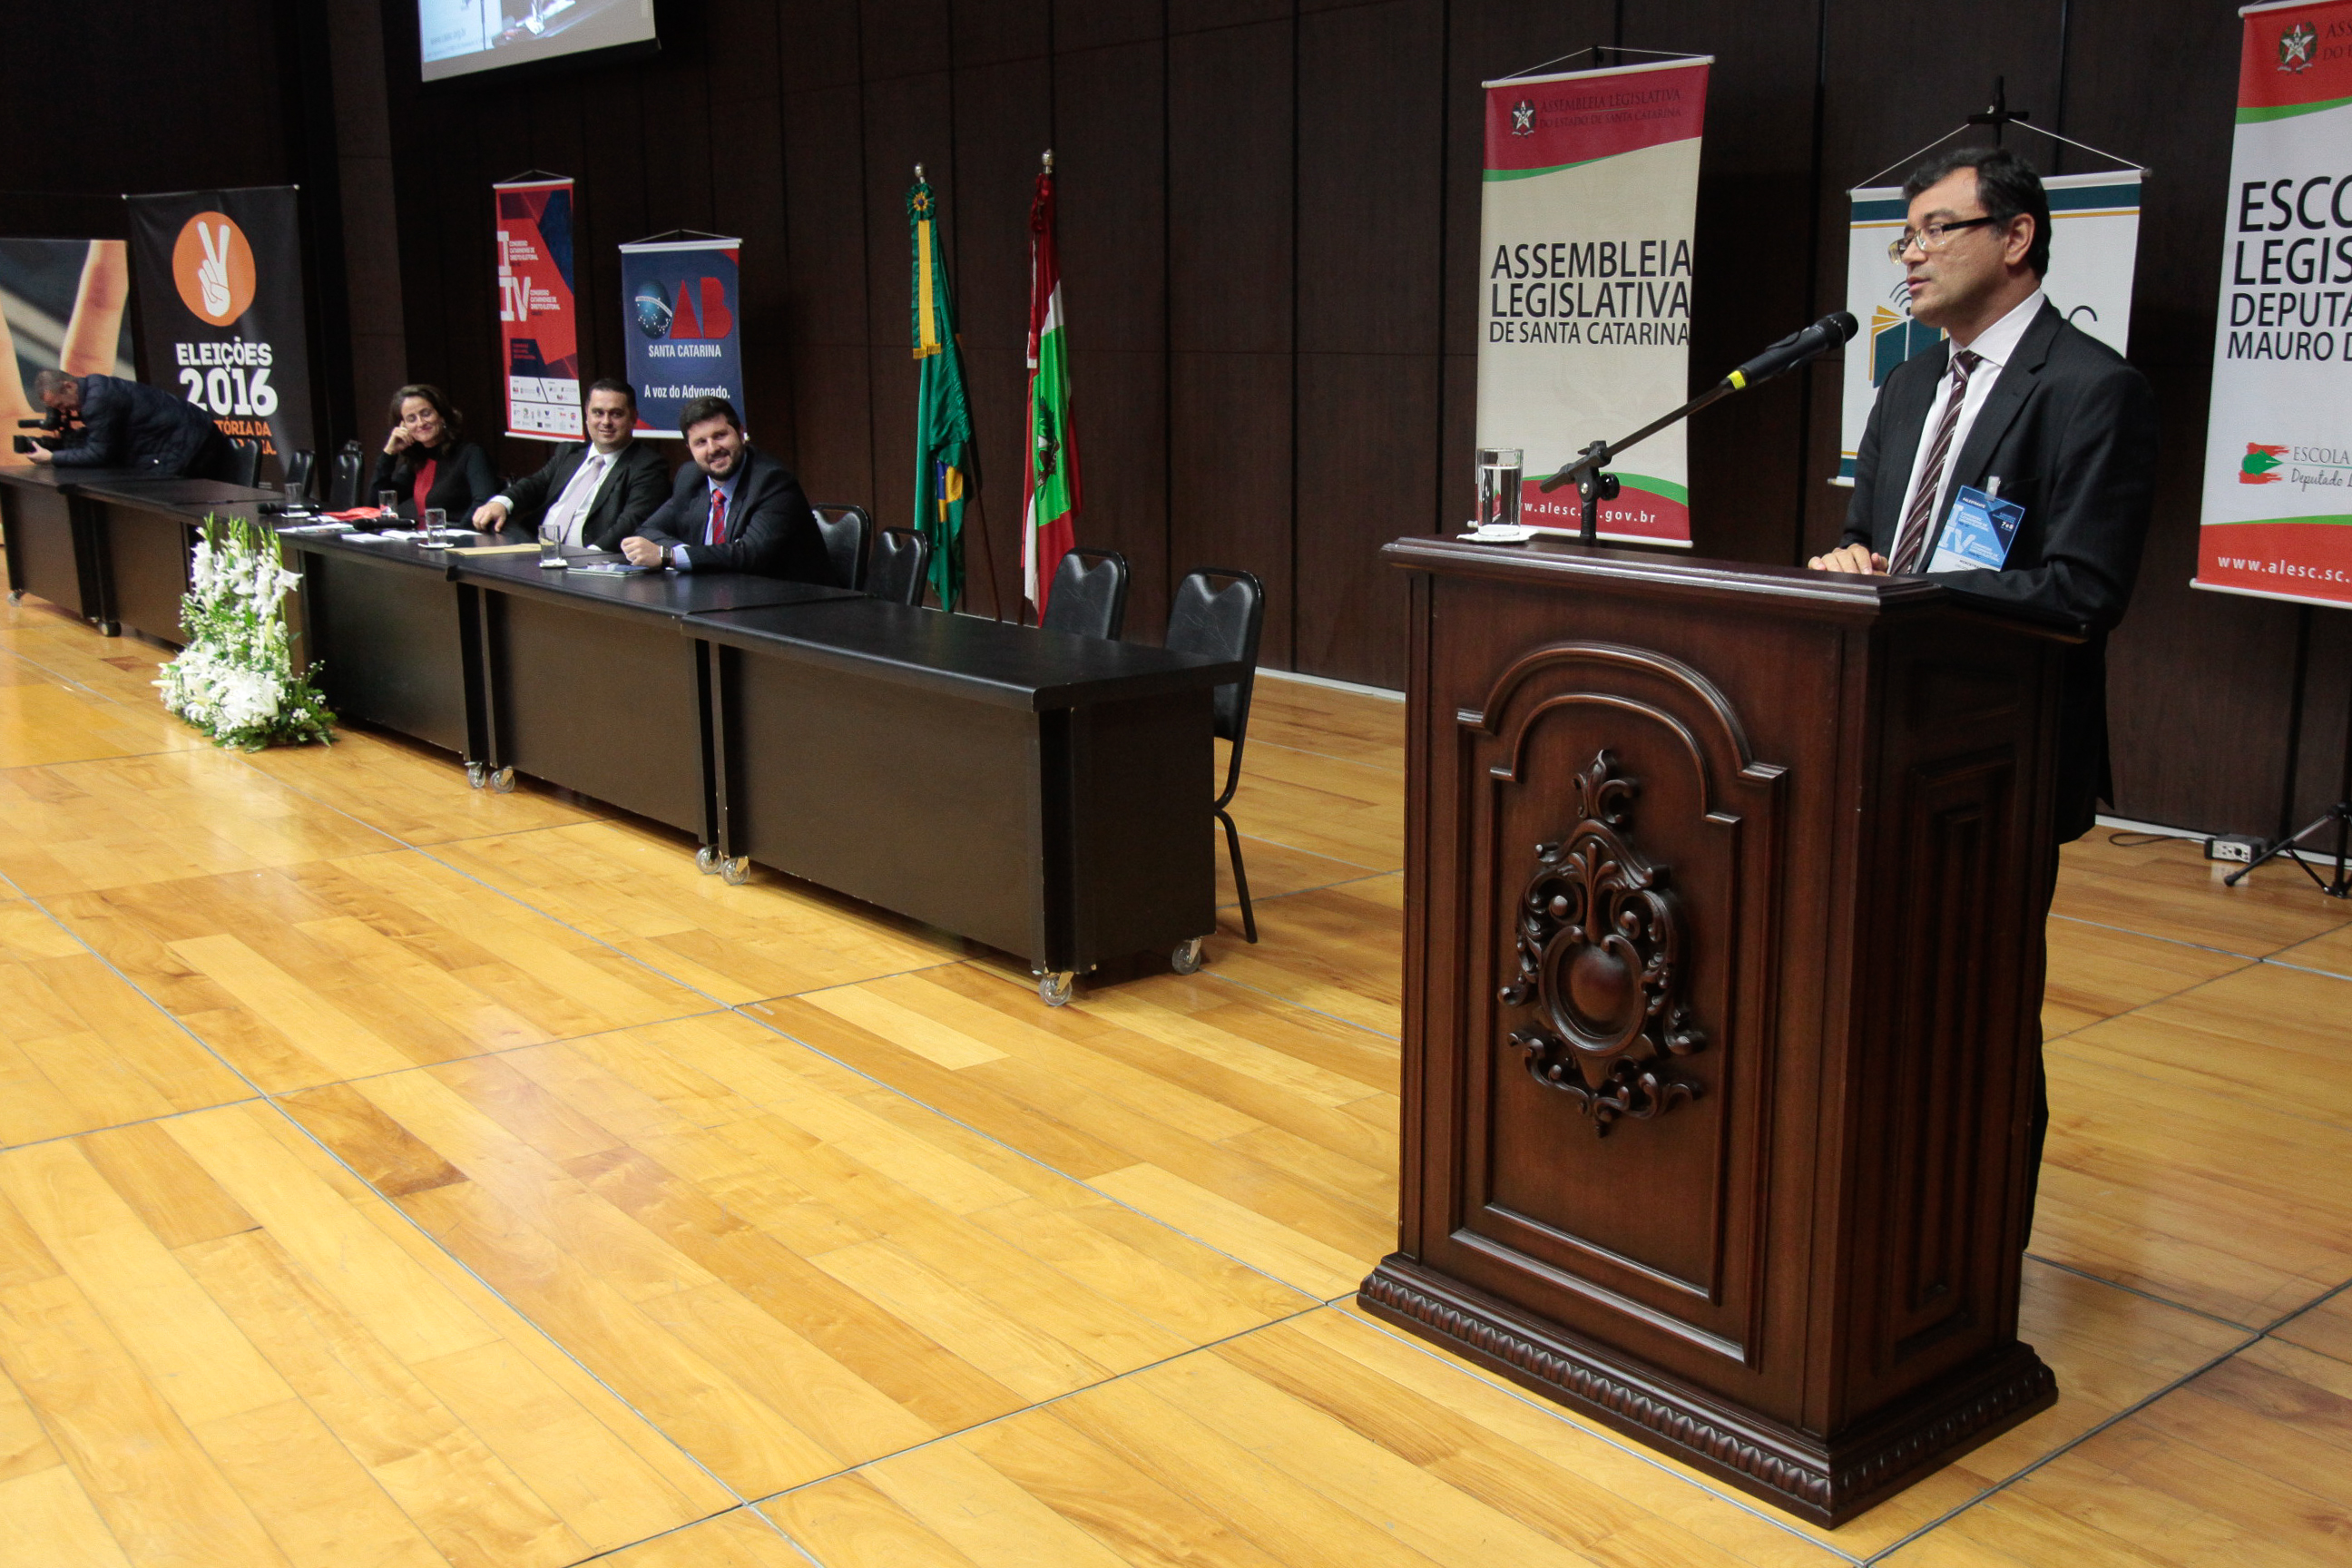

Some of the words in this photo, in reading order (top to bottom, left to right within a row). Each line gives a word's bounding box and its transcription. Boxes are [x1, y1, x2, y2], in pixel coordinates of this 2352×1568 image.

[1541, 96, 1606, 113] ASSEMBLEIA
[1609, 89, 1680, 106] LEGISLATIVA
[1606, 111, 1632, 123] SANTA
[1635, 107, 1681, 121] CATARINA
[1490, 240, 1692, 279] ASSEMBLEIA
[2233, 236, 2352, 286] LEGIS
[498, 277, 532, 321] IV
[1491, 281, 1690, 318] LEGISLATIVA
[1489, 321, 1514, 343] DE
[1520, 321, 1581, 344] SANTA
[1587, 321, 1690, 346] CATARINA
[2227, 331, 2334, 361] MAURO
[175, 336, 273, 372] ELEIÇÕES
[649, 345, 676, 358] SANTA
[678, 345, 721, 358] CATARINA
[180, 368, 279, 416] 2016
[644, 384, 652, 397] A
[652, 387, 667, 397] voz
[669, 385, 680, 398] do
[213, 416, 254, 436] TÓRIA
[255, 421, 272, 436] DA
[2293, 446, 2350, 465] ESCOLA
[2291, 467, 2343, 492] Deputado
